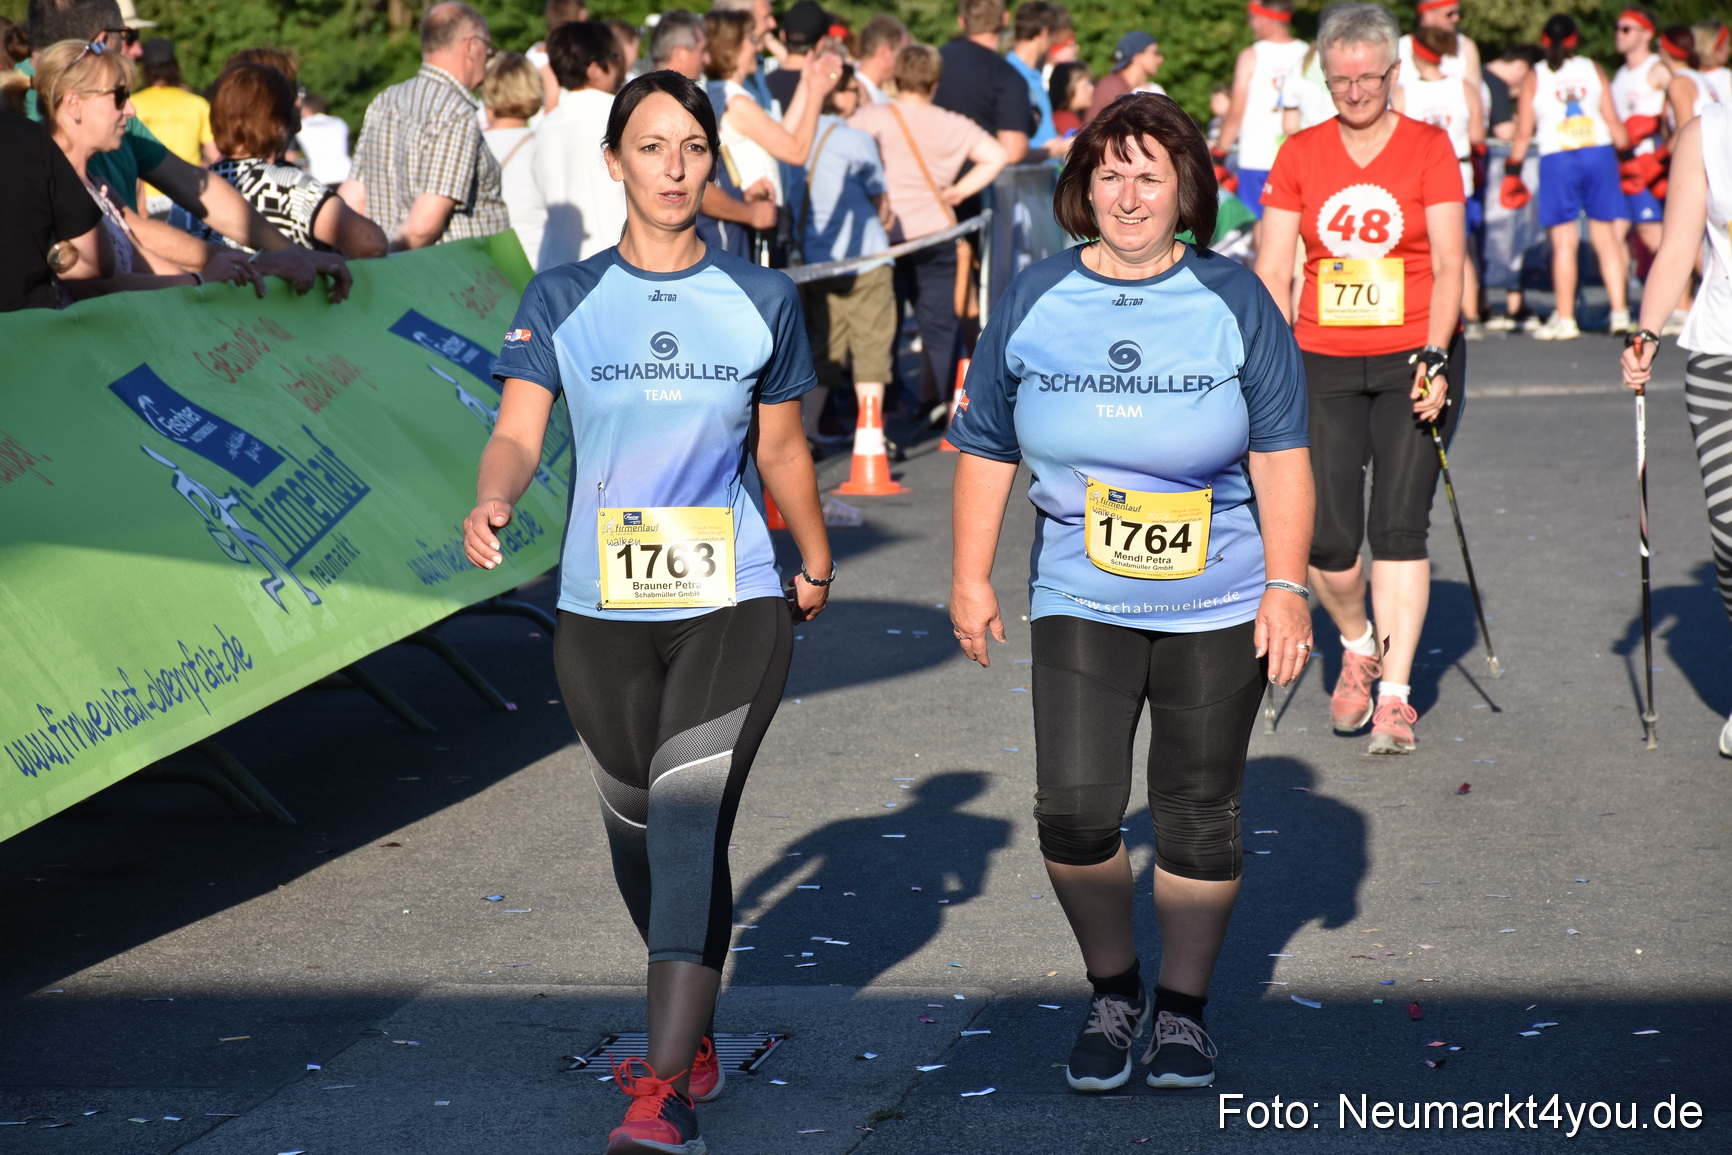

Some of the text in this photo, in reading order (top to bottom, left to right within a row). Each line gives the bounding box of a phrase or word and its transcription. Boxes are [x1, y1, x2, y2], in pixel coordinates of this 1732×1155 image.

[1327, 204, 1391, 243] 48
[1334, 284, 1380, 306] 770
[590, 362, 739, 383] SCHABMÜLLER
[1038, 373, 1215, 394] SCHABMÜLLER
[643, 390, 682, 401] TEAM
[158, 406, 202, 436] Fischer
[1096, 404, 1143, 418] TEAM
[229, 424, 371, 560] firmenlauf
[1100, 496, 1142, 513] firmenlauf
[615, 523, 660, 532] firmenlauf
[1099, 517, 1192, 554] 1764
[309, 531, 360, 590] neumarkt
[616, 543, 717, 579] 1763
[1110, 558, 1151, 570] Schabmüller
[1114, 550, 1172, 564] Mendl Petra
[632, 580, 702, 590] Brauner Petra
